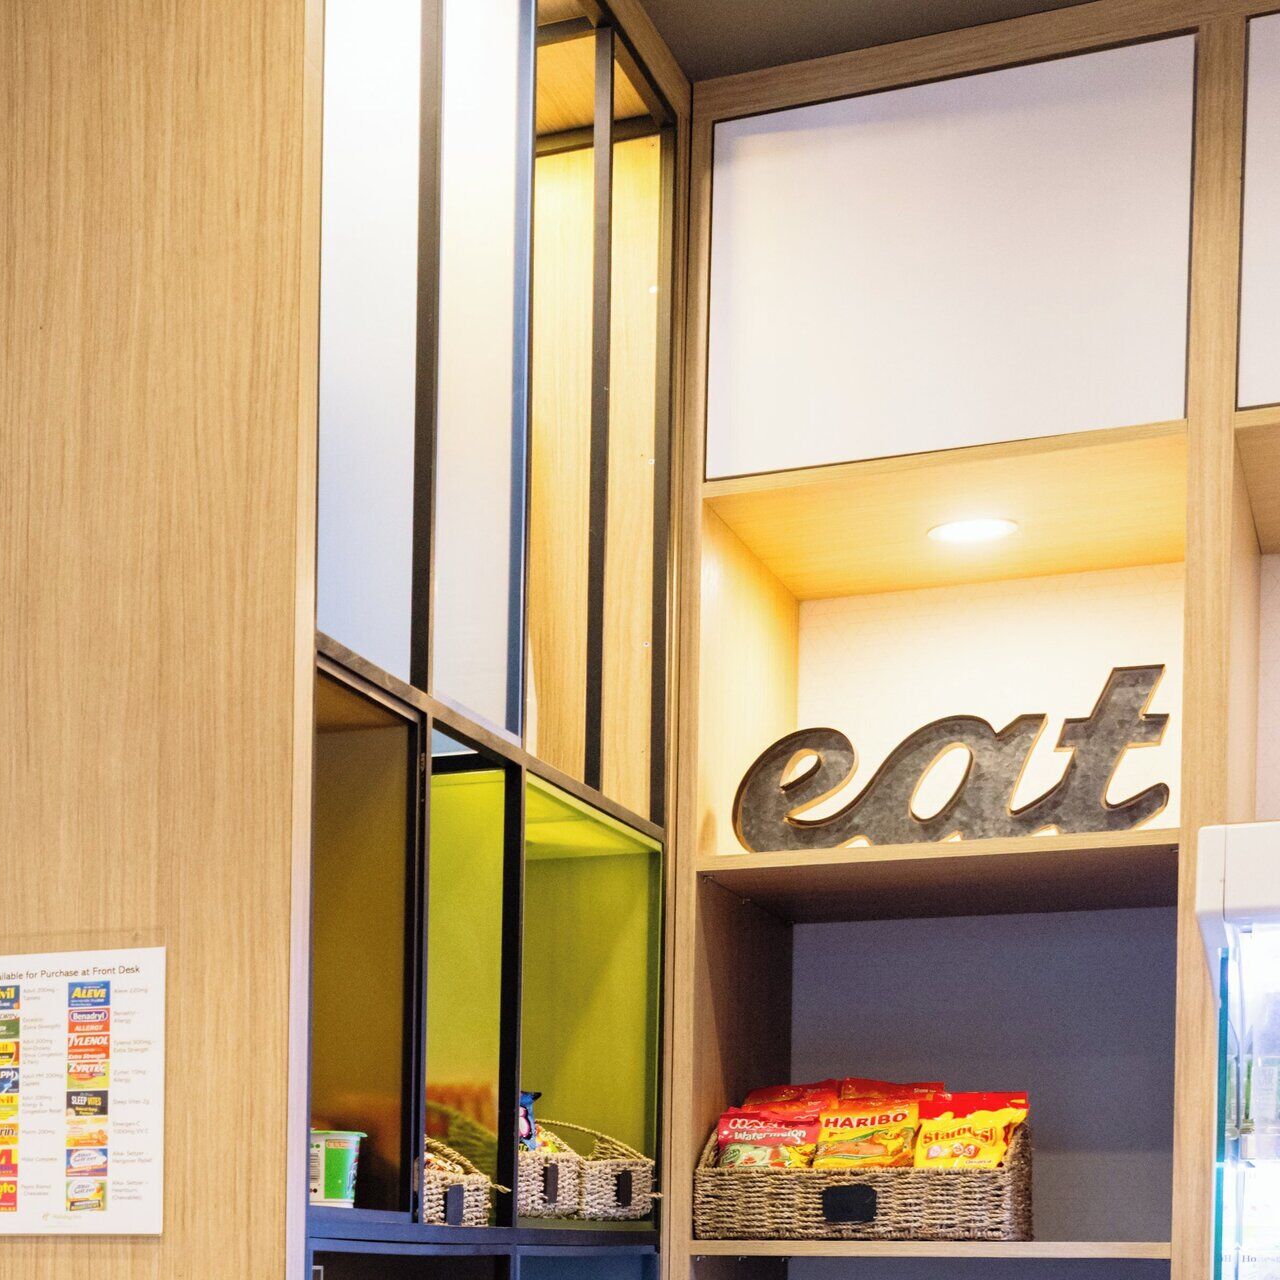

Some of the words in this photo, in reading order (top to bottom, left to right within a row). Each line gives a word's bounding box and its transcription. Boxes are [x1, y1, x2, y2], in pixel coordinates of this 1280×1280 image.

[732, 663, 1171, 854] eat
[26, 970, 37, 978] for
[40, 969, 79, 978] Purchase
[92, 967, 117, 975] Front
[118, 965, 140, 974] Desk
[72, 988, 106, 998] ALEVE
[73, 1012, 105, 1021] Benadryl
[69, 1034, 108, 1047] TYLENOL
[71, 1096, 87, 1105] SLEEP
[824, 1113, 908, 1128] HARIBO
[734, 1130, 807, 1142] Watermelon
